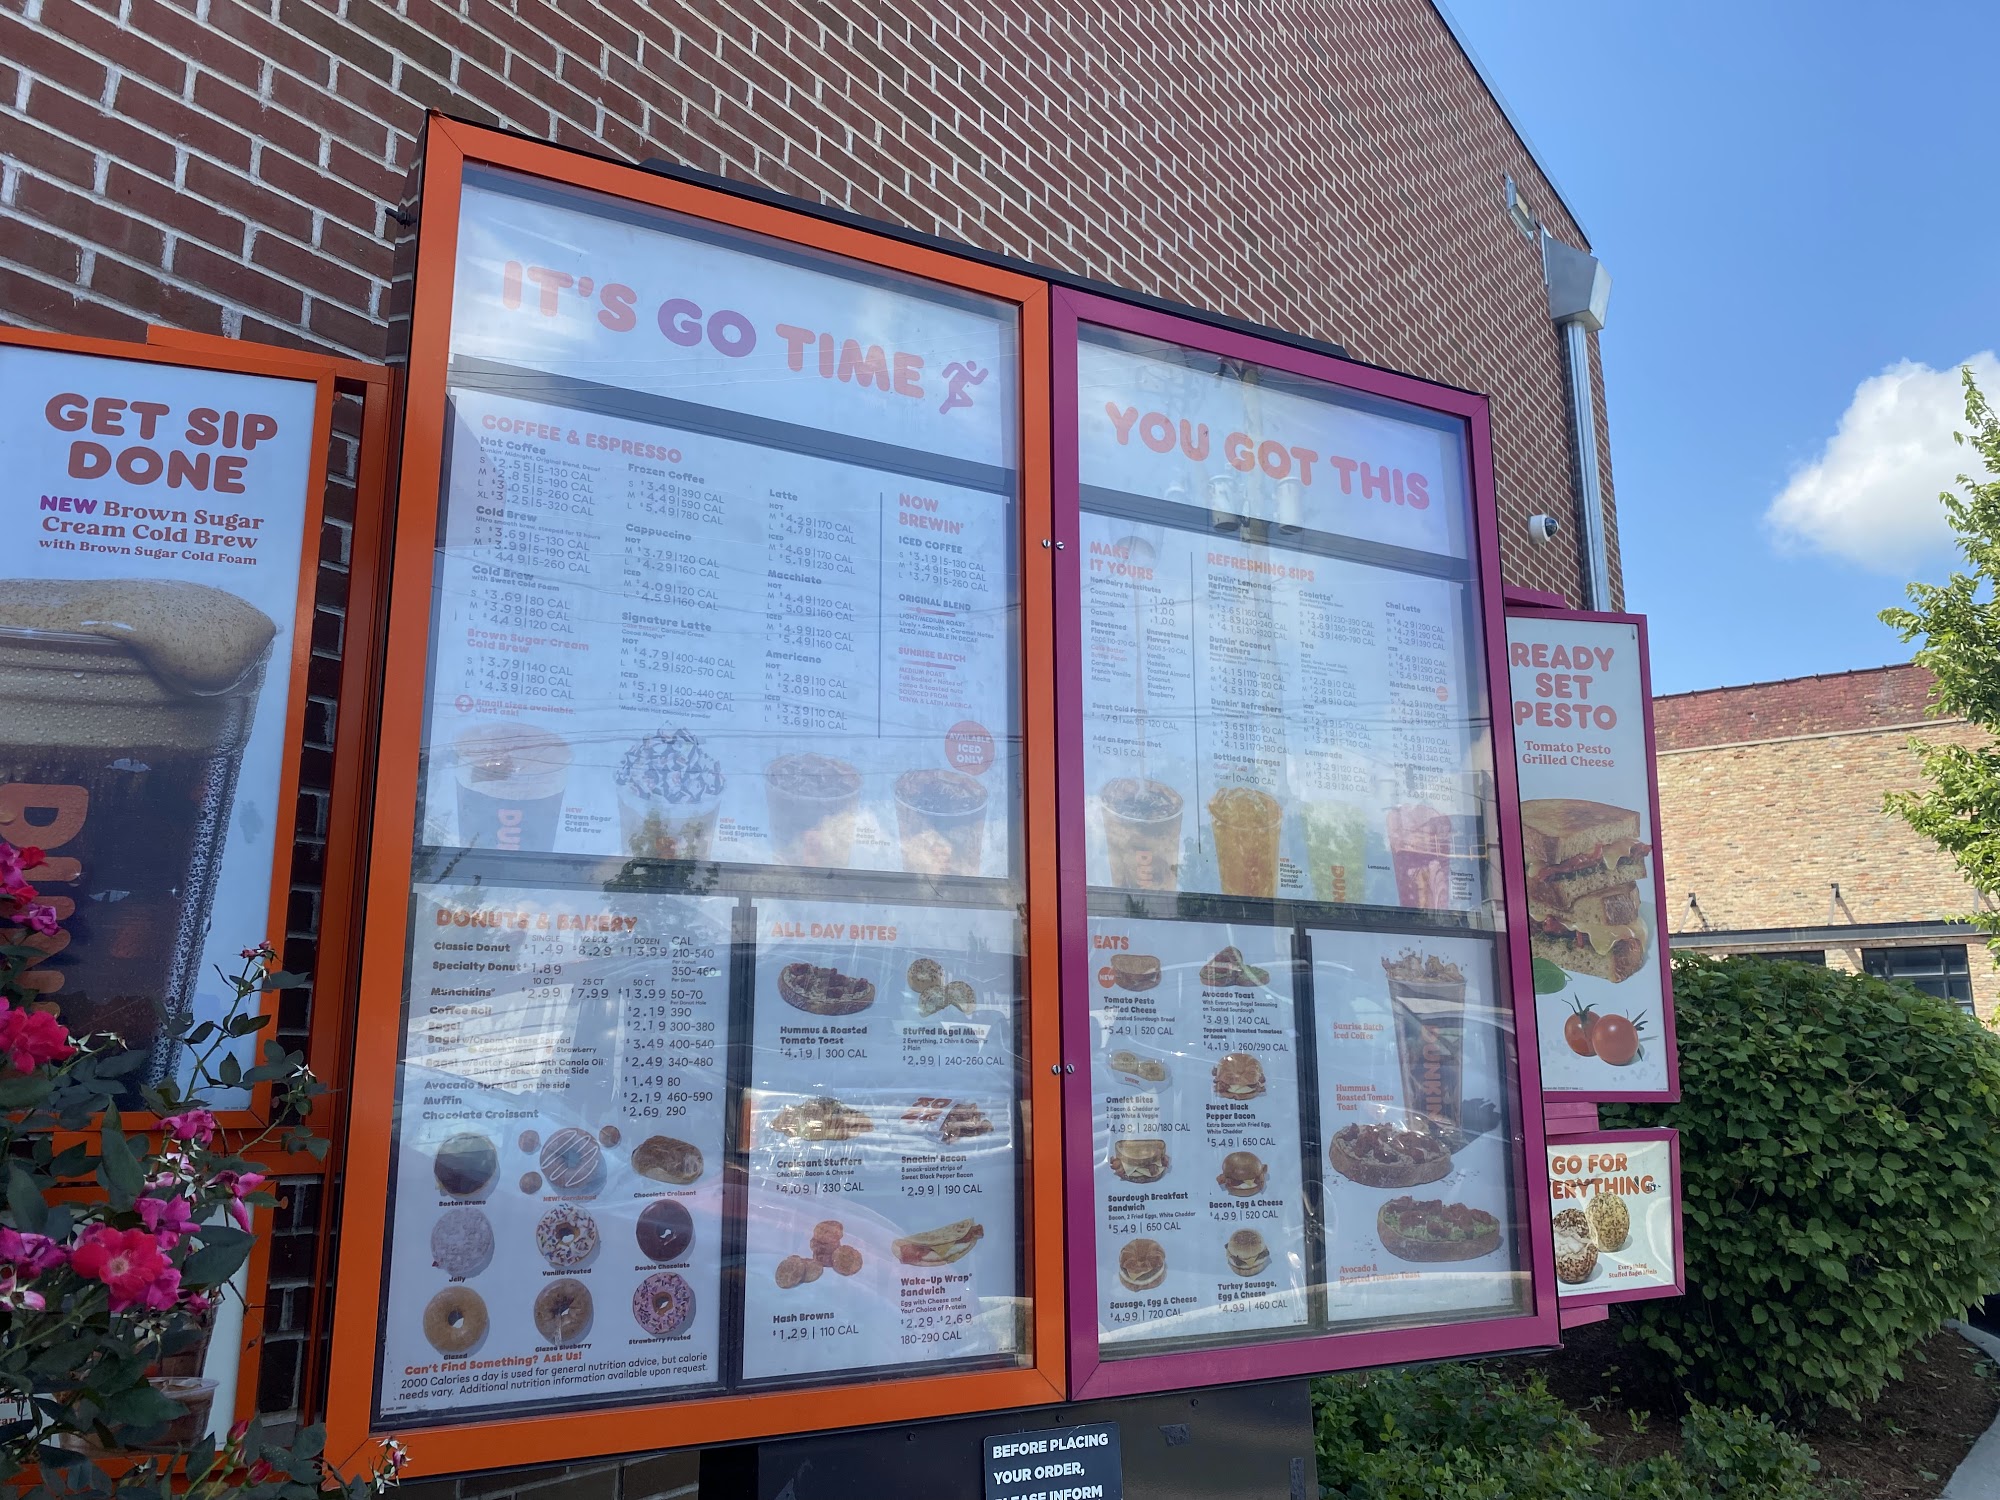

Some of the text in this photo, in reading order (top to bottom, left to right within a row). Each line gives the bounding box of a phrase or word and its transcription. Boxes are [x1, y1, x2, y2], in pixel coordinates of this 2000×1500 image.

[503, 260, 925, 399] IT'S GO TIME
[45, 392, 278, 451] GET SIP
[481, 436, 546, 455] Hot Coffee
[482, 415, 682, 463] COFFEE & ESPRESSO
[1105, 402, 1430, 510] YOU GOT THIS
[68, 441, 248, 494] DONE
[628, 463, 705, 484] Frozen Coffee
[770, 489, 798, 501] Latte
[899, 493, 939, 512] NOW
[40, 495, 265, 531] NEW Brown Sugar
[476, 505, 537, 522] Cold Brew
[42, 516, 258, 549] Cream Cold Brew
[626, 524, 691, 542] Cappuccino
[39, 538, 257, 565] with Brown Sugar Cold Foam
[899, 536, 962, 554] ICED COFFEE
[1090, 541, 1129, 560] MAKE
[1090, 559, 1153, 580] IT YOURS
[1208, 553, 1314, 582] REFRESHING SIPS
[768, 570, 822, 585] Macchiato
[899, 594, 971, 611] ORIGINAL BLEND
[622, 612, 711, 632] Signature Latte
[467, 629, 589, 651] Brown Sugar Cream
[766, 650, 822, 664] Americano
[1510, 642, 1614, 672] READY
[1536, 673, 1593, 700] SET
[1514, 701, 1617, 730] PESTO
[1524, 741, 1611, 754] Tomato Pesto
[1522, 754, 1614, 767] Grilled Cheese
[436, 909, 637, 932] DONUTS & BAKERY
[771, 922, 897, 941] ALL DAY BITES
[671, 936, 693, 946] CAL
[1093, 935, 1129, 950] EATS
[434, 942, 714, 958] Classic Donut 210-540
[432, 961, 522, 972] Specialty Donut
[671, 990, 703, 999] 50-70
[670, 1007, 692, 1016] 390
[670, 1022, 715, 1031] 300-380
[780, 1026, 820, 1034] Hummus
[830, 1026, 867, 1034] Roasted
[903, 1028, 935, 1036] Stuffed
[669, 1039, 715, 1049] 400-540
[780, 1036, 816, 1044] Tomato
[826, 1049, 868, 1058] 300 CAL
[945, 1056, 1004, 1066] 240-260 CAL
[668, 1057, 713, 1067] 340-480
[424, 1092, 712, 1105] Muffin 460-590
[423, 1106, 686, 1120] Chocolate Croissant 290
[1552, 1153, 1627, 1175] GO FOR
[844, 1182, 864, 1192] CAL
[963, 1184, 982, 1194] CAL
[1108, 1192, 1188, 1202] Sourdough Breakfast
[1108, 1203, 1145, 1212] Sandwich
[901, 1275, 942, 1286] Wake-Up
[901, 1286, 946, 1296] Sandwich
[1147, 1299, 1162, 1307] Egg
[773, 1311, 834, 1323] Hash Browns
[838, 1325, 858, 1335] CAL
[901, 1330, 962, 1344] 180-290 CAL
[401, 1378, 427, 1389] 2000
[430, 1373, 470, 1386] Calories
[481, 1371, 499, 1382] day
[501, 1370, 508, 1378] is
[511, 1368, 533, 1378] used
[536, 1366, 549, 1376] for
[551, 1364, 586, 1376] general
[588, 1359, 626, 1371] nutrition
[629, 1356, 659, 1367] advice,
[662, 1355, 676, 1364] but
[679, 1353, 708, 1362] calorie
[404, 1352, 582, 1375] Can't Find Something? Ask Us!
[400, 1363, 708, 1400] needs vary. Additional nutrition information available upon request.
[993, 1433, 1108, 1458] BEFORE PLACING
[994, 1462, 1085, 1484] YOUR ORDER,
